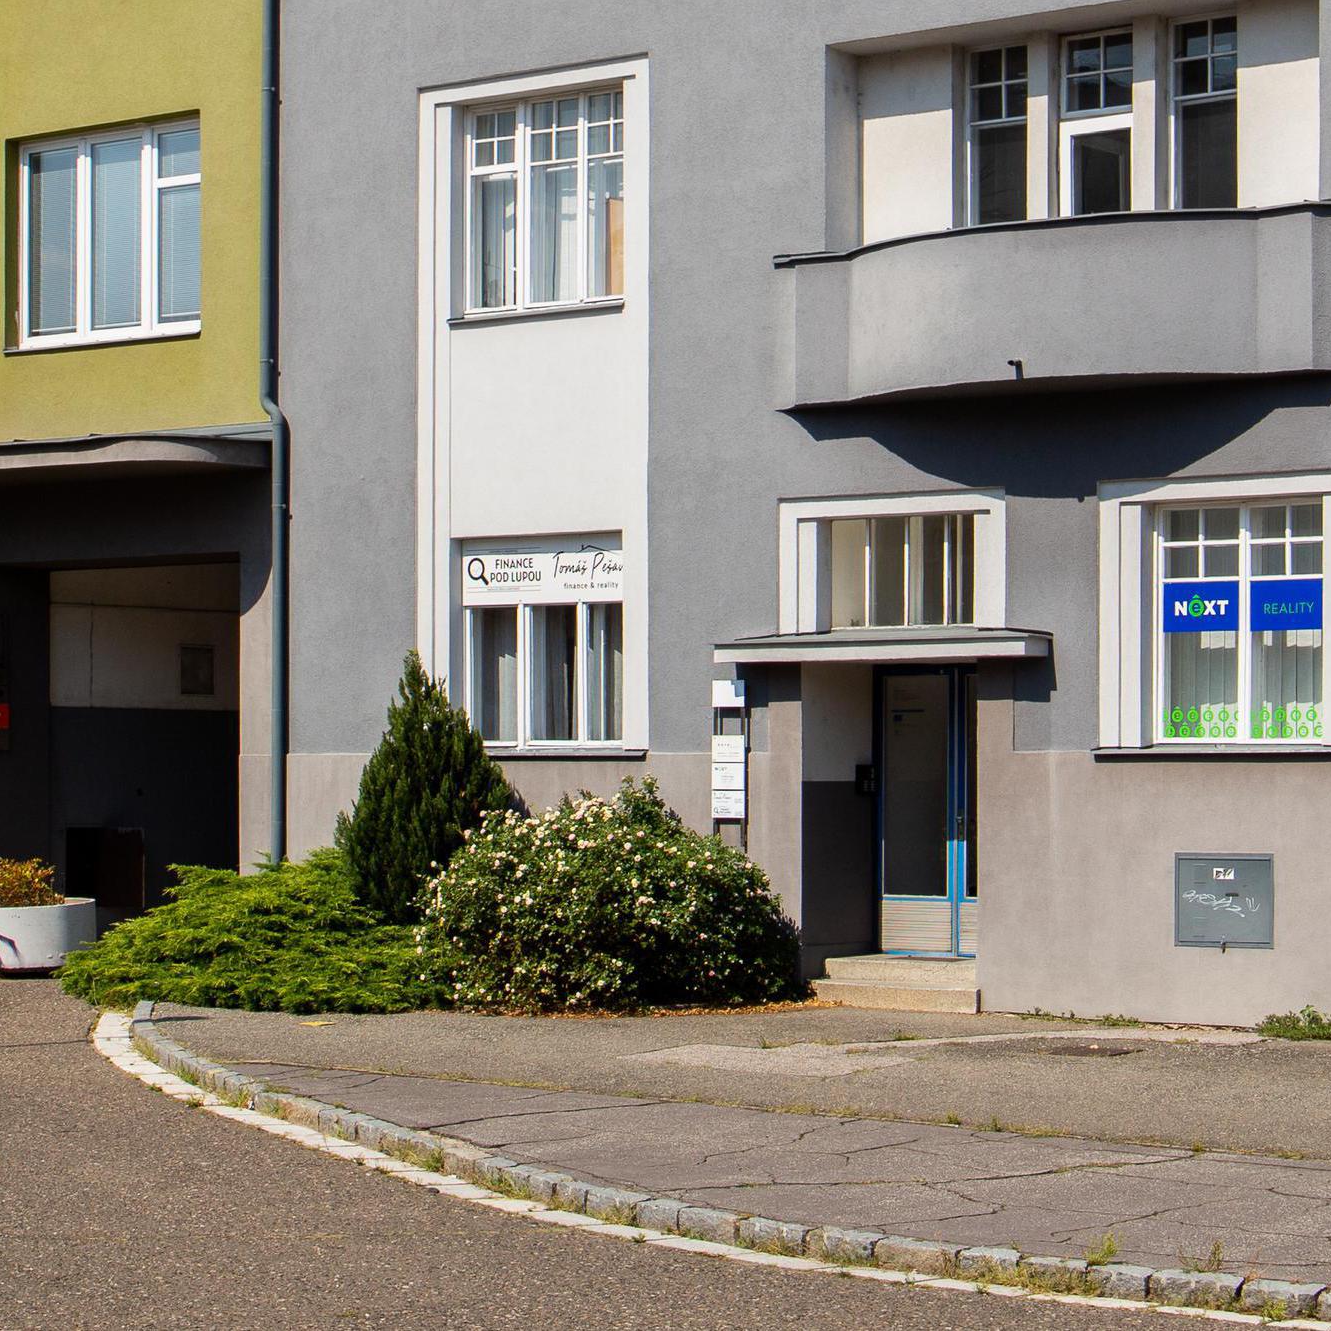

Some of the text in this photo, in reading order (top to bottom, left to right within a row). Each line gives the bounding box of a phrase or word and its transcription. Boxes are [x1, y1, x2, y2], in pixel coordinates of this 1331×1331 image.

[495, 558, 533, 569] FINANCE
[553, 551, 587, 578] Tomáš
[490, 571, 541, 583] POD LUPOU
[564, 581, 619, 590] finance & reality
[1263, 602, 1314, 615] REALITY
